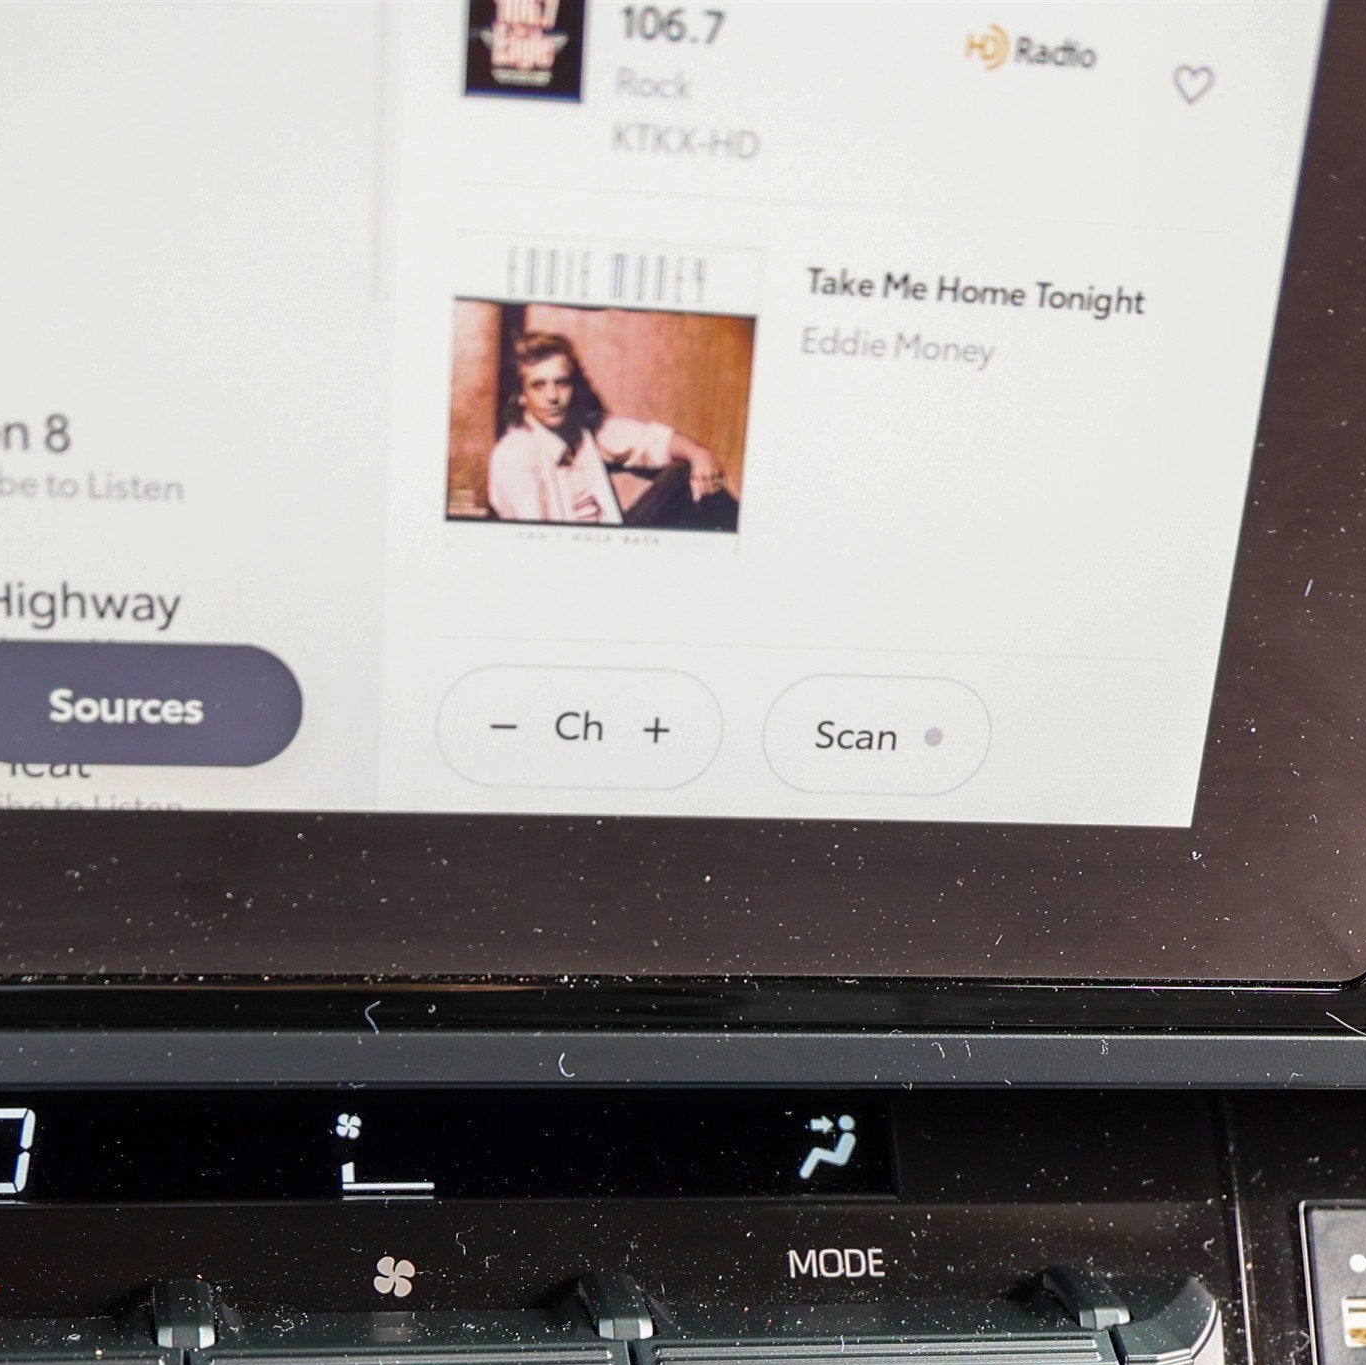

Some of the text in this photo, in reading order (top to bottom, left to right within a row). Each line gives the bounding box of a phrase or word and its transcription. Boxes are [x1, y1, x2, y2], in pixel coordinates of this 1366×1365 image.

[621, 5, 728, 44] 106.7
[1014, 36, 1099, 69] Radio
[614, 66, 692, 98] Rock
[611, 122, 762, 159] KTKX-HD
[808, 267, 1148, 321] Take Me Home Tonight
[800, 326, 997, 372] Eddie Money
[43, 413, 72, 454] 8
[46, 470, 80, 499] to
[87, 469, 185, 502] Listen
[49, 688, 205, 726] Sources
[554, 710, 604, 742] Ch
[815, 720, 898, 752] Scan
[789, 1247, 886, 1279] MODE
